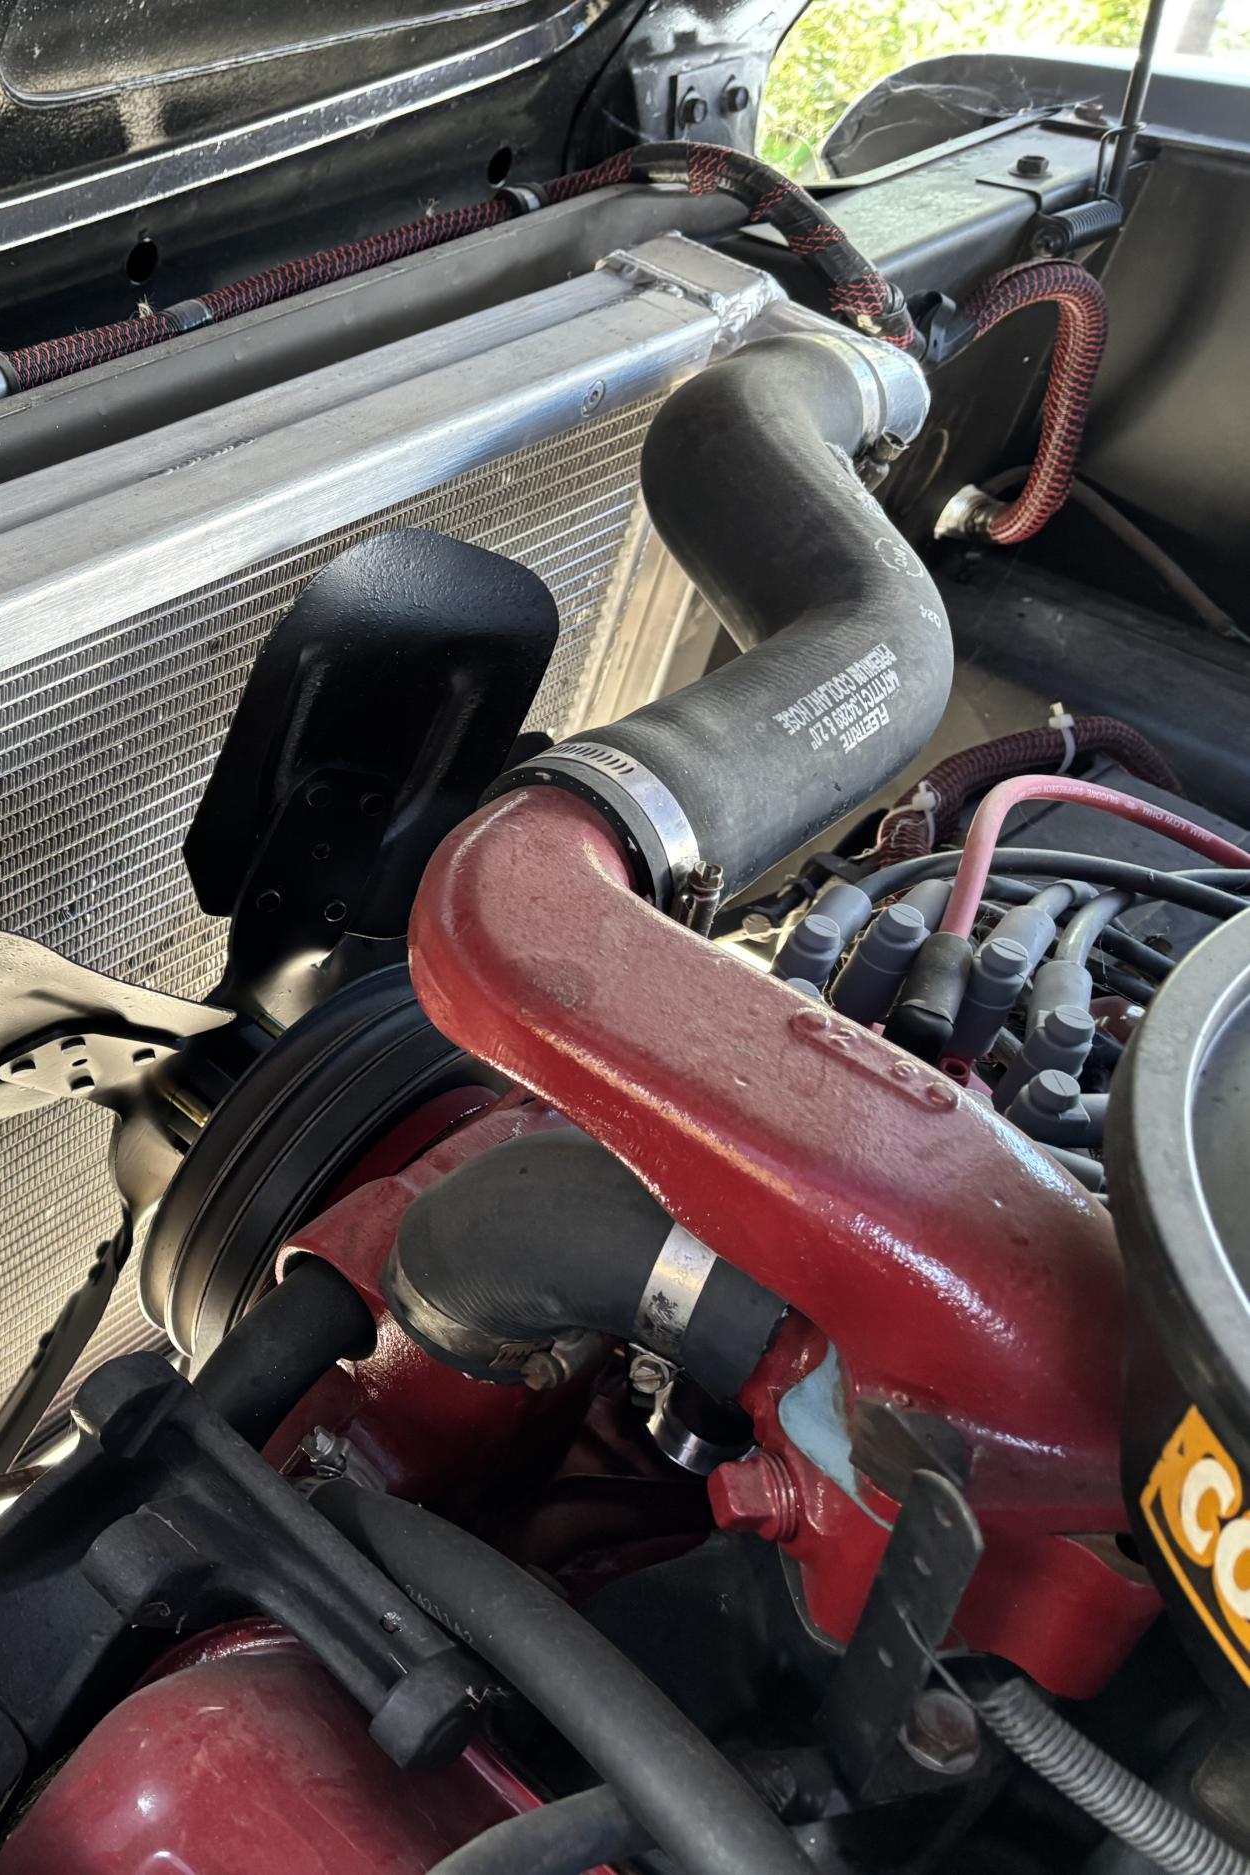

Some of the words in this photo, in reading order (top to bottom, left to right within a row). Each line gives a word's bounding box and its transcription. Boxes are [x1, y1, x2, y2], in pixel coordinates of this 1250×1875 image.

[844, 642, 899, 686] PREMIUM
[806, 672, 857, 721] COOLANT
[823, 717, 838, 738] &
[840, 703, 890, 755] FLEETRITE
[1142, 807, 1164, 821] OHM
[1165, 816, 1187, 831] LOW
